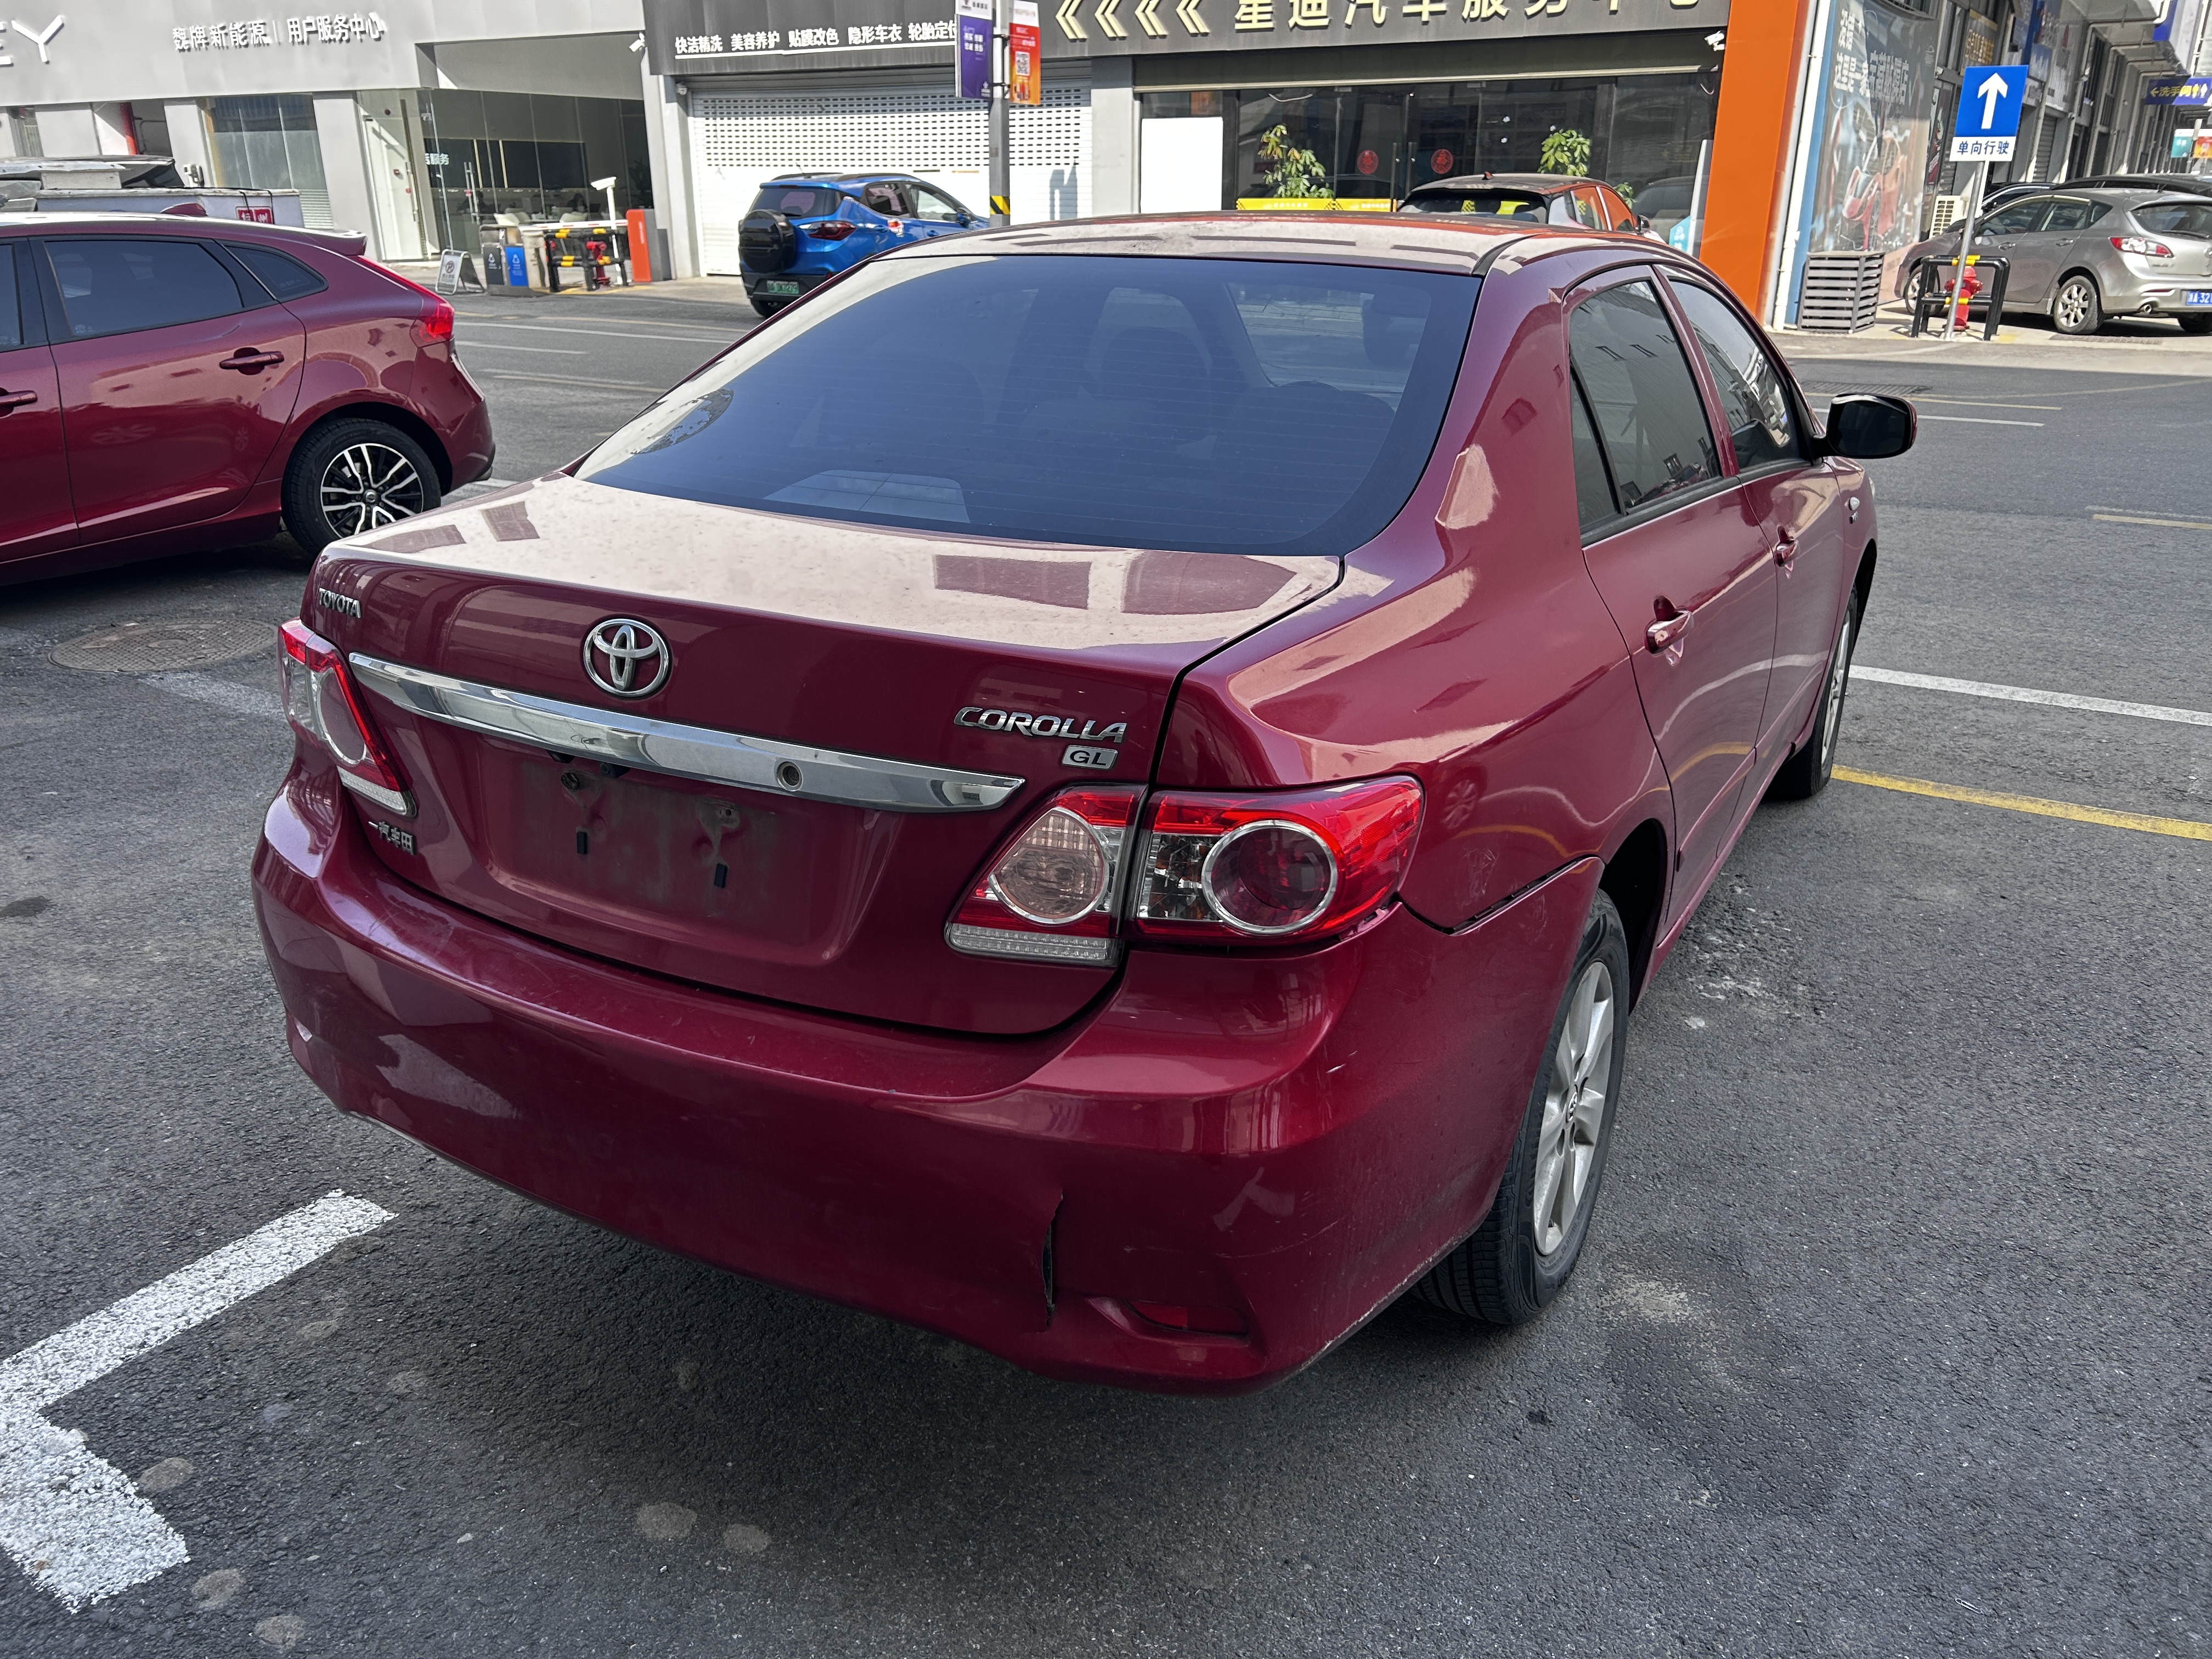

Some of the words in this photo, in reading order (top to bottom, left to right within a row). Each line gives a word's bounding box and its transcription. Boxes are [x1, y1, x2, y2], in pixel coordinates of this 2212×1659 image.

[172, 19, 271, 51] 魏牌新能源
[287, 12, 383, 43] 用户服务中心
[675, 35, 723, 54] 快洁精洗
[731, 31, 780, 51] 美容养护
[788, 27, 839, 48] 贴膜改色
[848, 24, 902, 45] 隐形车衣
[1957, 140, 2010, 155] 单向行驶
[319, 588, 362, 619] TOYOTA
[953, 707, 1128, 743] COROLLA
[1070, 750, 1107, 766] GL
[368, 821, 414, 856] 一汽丰田
